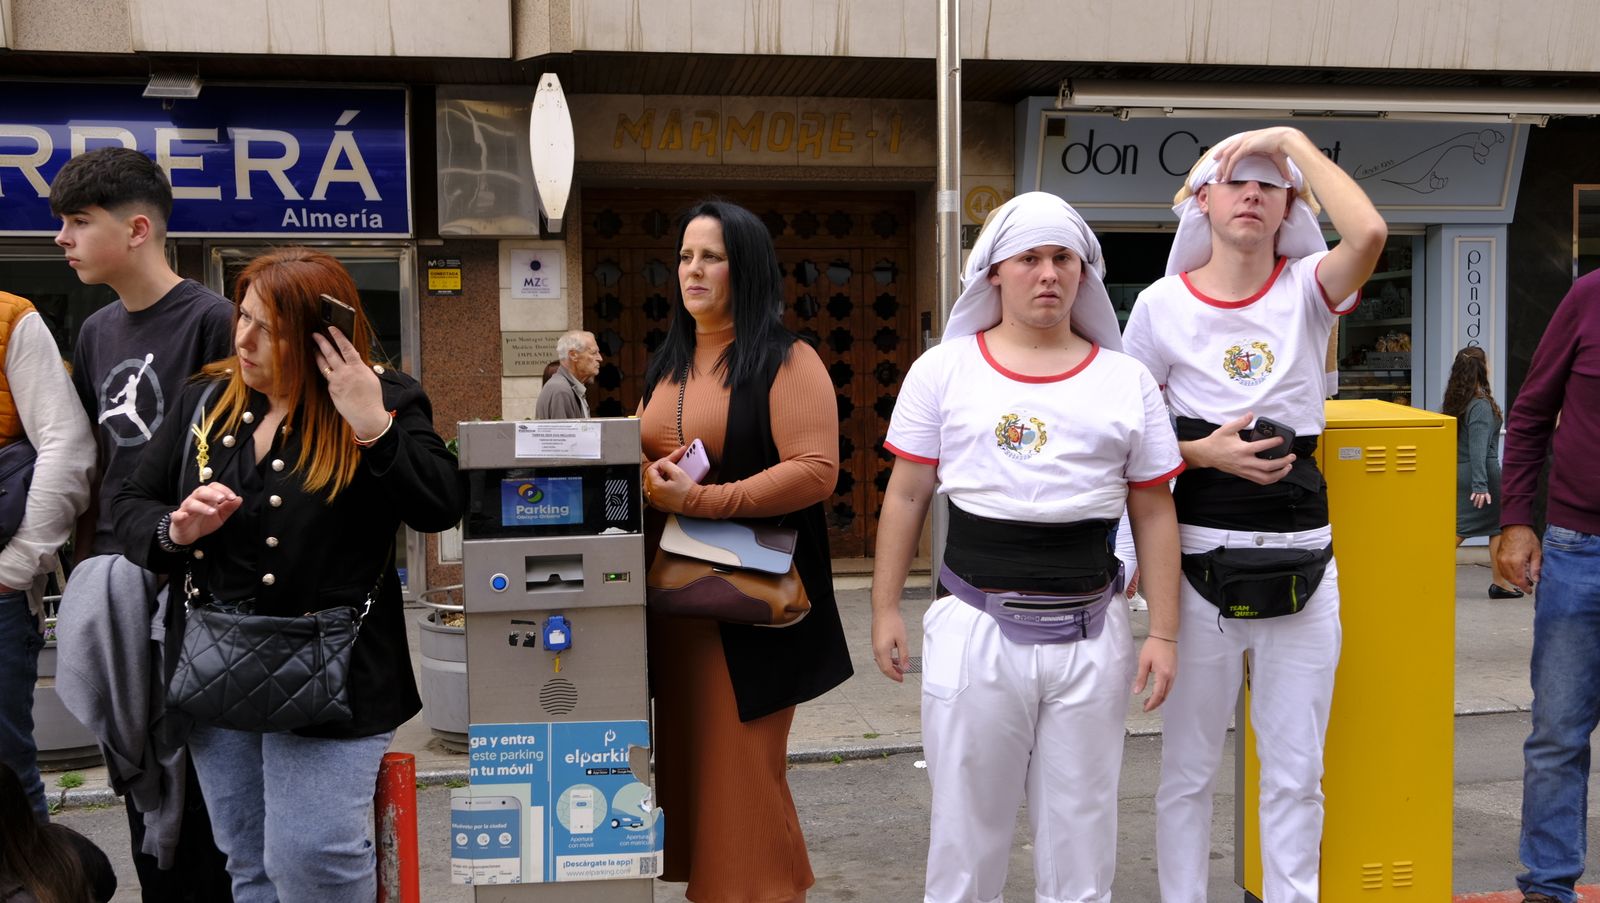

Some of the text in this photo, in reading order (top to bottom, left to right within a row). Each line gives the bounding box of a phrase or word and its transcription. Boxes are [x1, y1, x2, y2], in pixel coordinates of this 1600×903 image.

[613, 108, 856, 159] MARMORE
[1061, 129, 1138, 175] don
[282, 208, 383, 228] Almería
[524, 277, 549, 287] MZC
[516, 505, 570, 515] Parking
[490, 737, 498, 748] y
[500, 735, 535, 745] entra
[472, 749, 544, 762] este parking
[481, 766, 494, 776] tu
[497, 763, 533, 776] móvil
[563, 859, 606, 868] ¡Descárgate
[617, 859, 633, 867] app!
